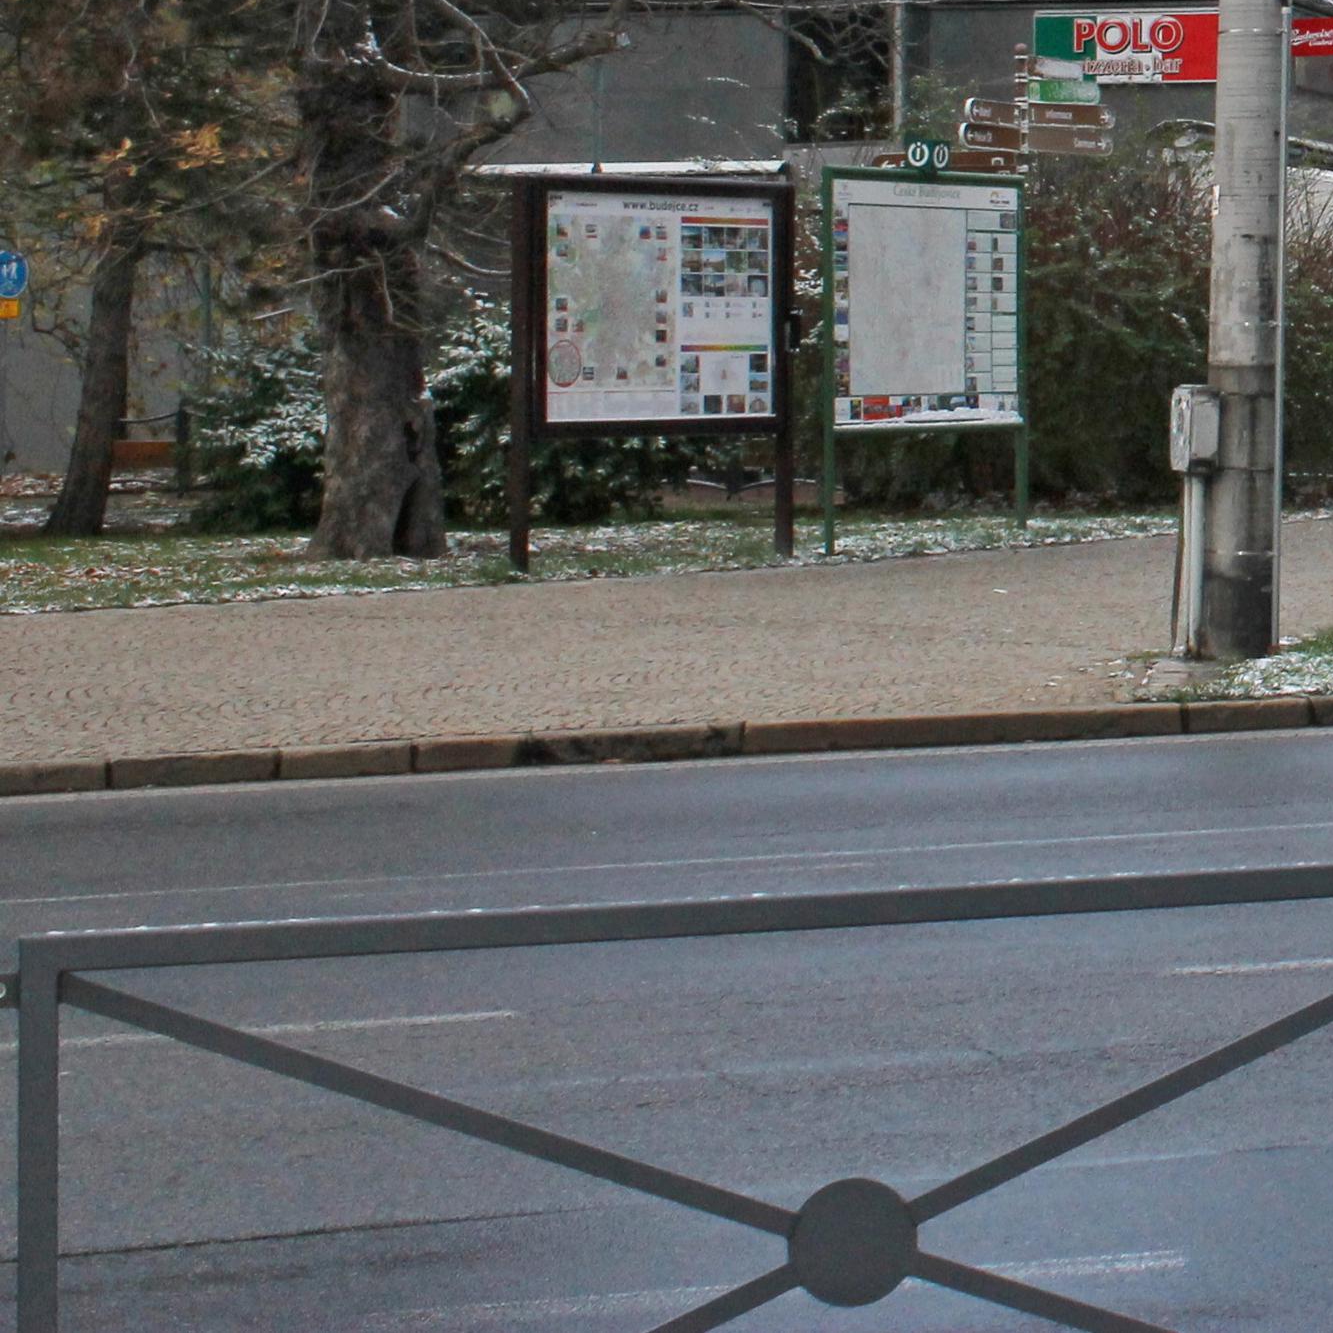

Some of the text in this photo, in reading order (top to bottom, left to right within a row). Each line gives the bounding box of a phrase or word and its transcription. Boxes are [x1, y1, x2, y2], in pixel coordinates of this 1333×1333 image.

[1073, 17, 1184, 54] POLO
[1083, 56, 1183, 75] izzeria bar
